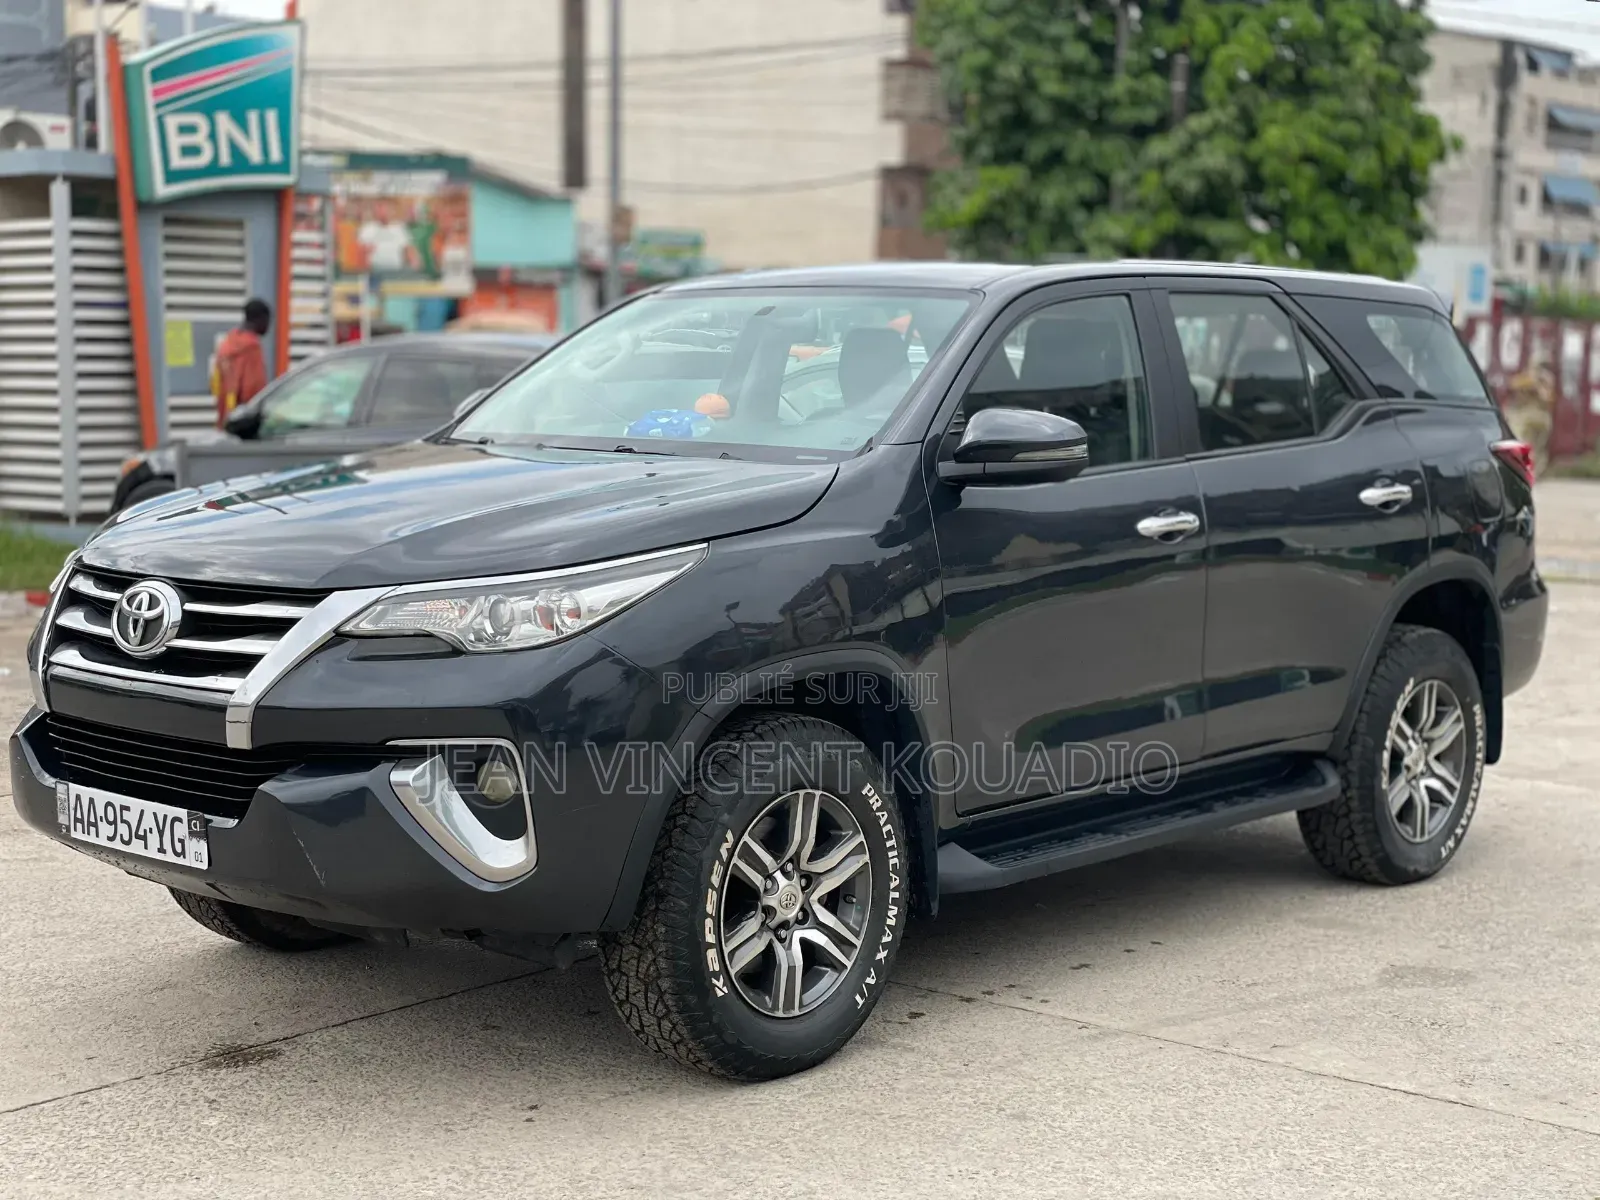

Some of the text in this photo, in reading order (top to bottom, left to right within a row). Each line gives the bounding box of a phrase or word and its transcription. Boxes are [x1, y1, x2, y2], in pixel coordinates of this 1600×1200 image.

[163, 107, 284, 171] BNI
[854, 782, 900, 1010] PRACTICALMAX A/T
